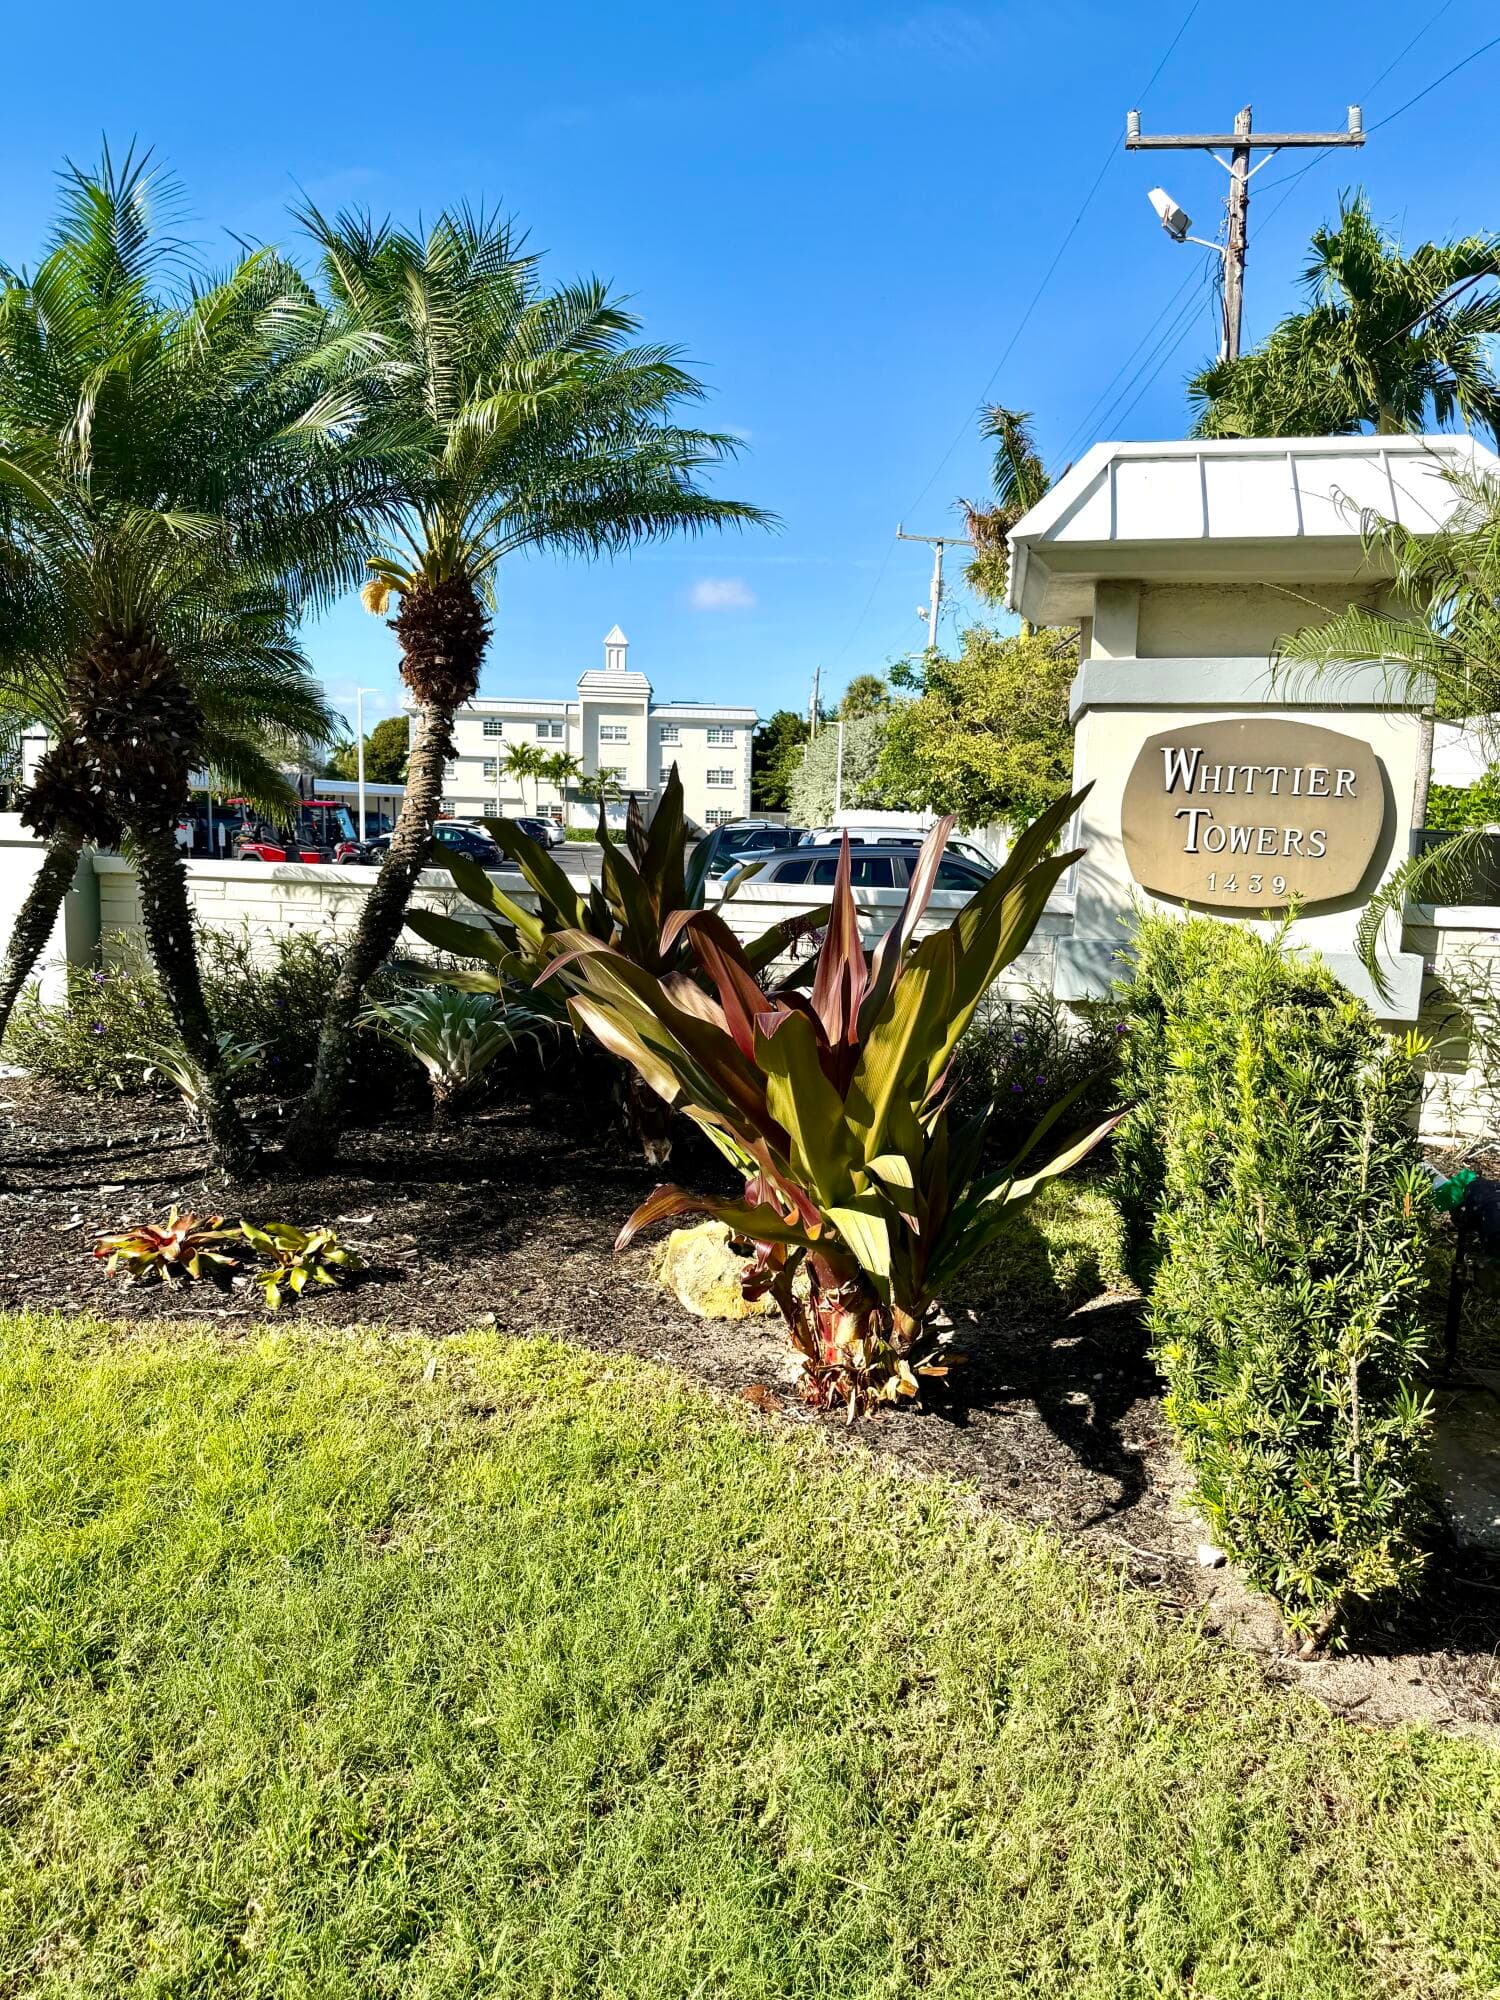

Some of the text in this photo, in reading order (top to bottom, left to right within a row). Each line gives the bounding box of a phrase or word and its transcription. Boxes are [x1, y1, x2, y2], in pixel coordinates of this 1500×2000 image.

[1160, 747, 1357, 798] WHITTIER
[1174, 807, 1328, 857] TOWERS
[1207, 872, 1287, 894] 1439
